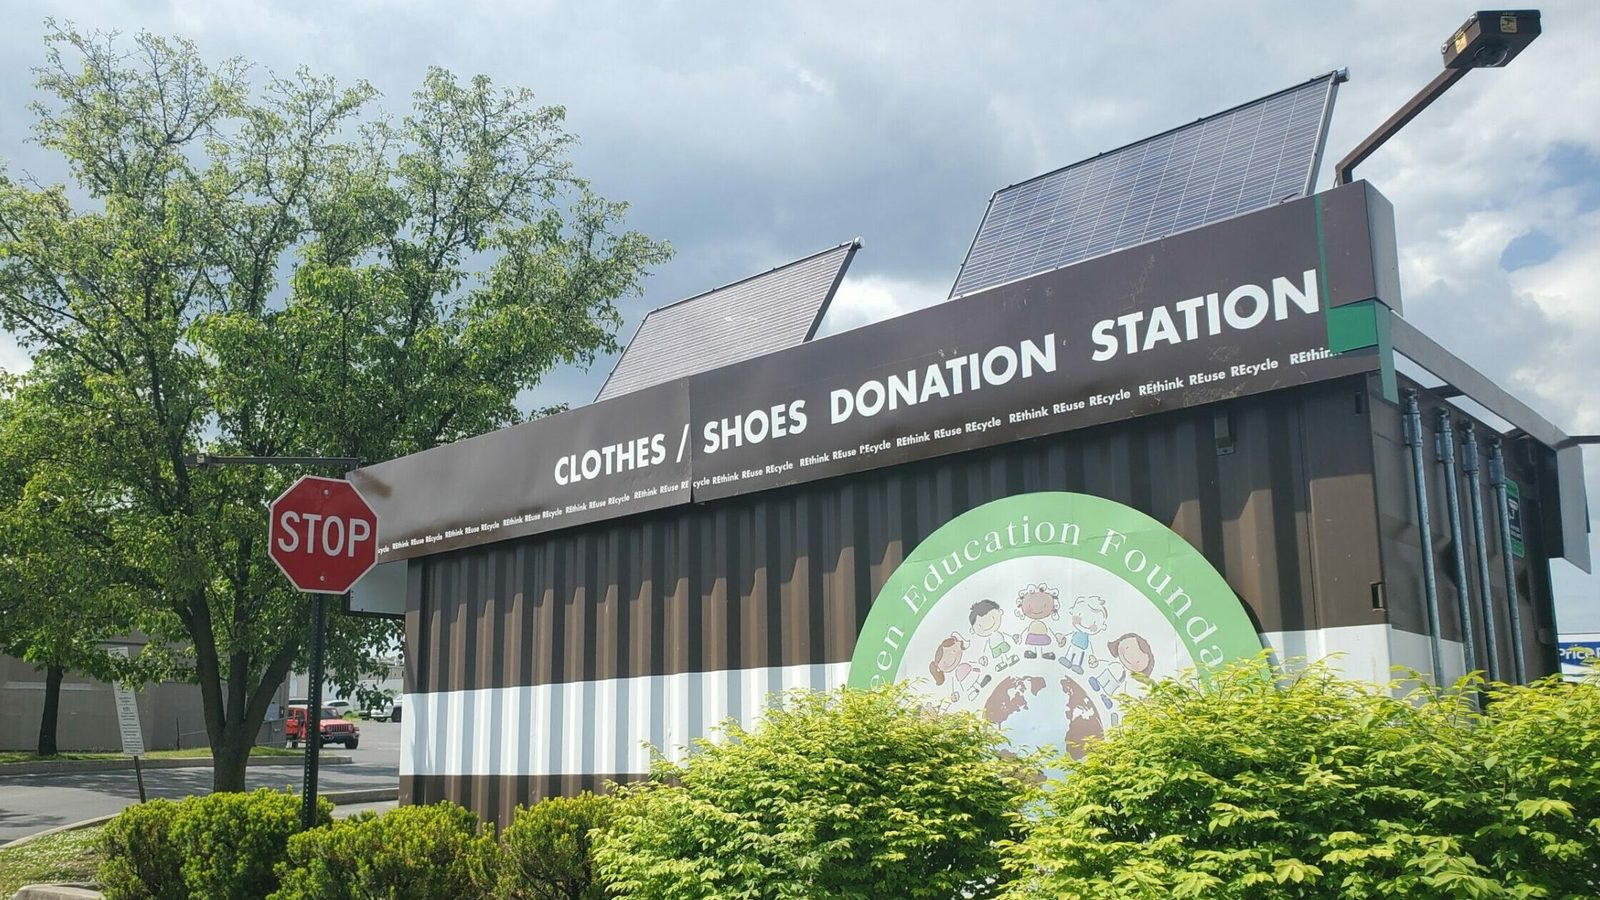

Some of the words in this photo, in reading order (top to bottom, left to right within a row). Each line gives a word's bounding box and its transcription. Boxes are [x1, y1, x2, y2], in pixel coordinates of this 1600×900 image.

[554, 433, 666, 485] CLOTHES
[676, 424, 689, 463] /
[703, 400, 808, 454] SHOES
[830, 333, 1057, 424] DONATION
[1091, 269, 1320, 362] STATION
[565, 503, 588, 514] REthink
[634, 487, 658, 499] REthink
[712, 471, 739, 485] REthink
[765, 461, 794, 475] REcycle
[800, 453, 830, 467] REthink
[833, 448, 857, 460] REuse
[896, 432, 930, 448] REthink
[934, 426, 962, 440] REuse
[965, 416, 1001, 433] REcycle
[1009, 407, 1049, 424] REthink
[1053, 400, 1085, 415] REuse
[1089, 389, 1131, 406] REcycle
[1138, 378, 1184, 397] REthink
[1189, 370, 1226, 386] REuse
[1230, 358, 1279, 378] REcycle
[1290, 347, 1343, 365] REthin
[278, 511, 371, 557] STOP
[902, 515, 1081, 614] Education
[1098, 528, 1224, 674] Founda
